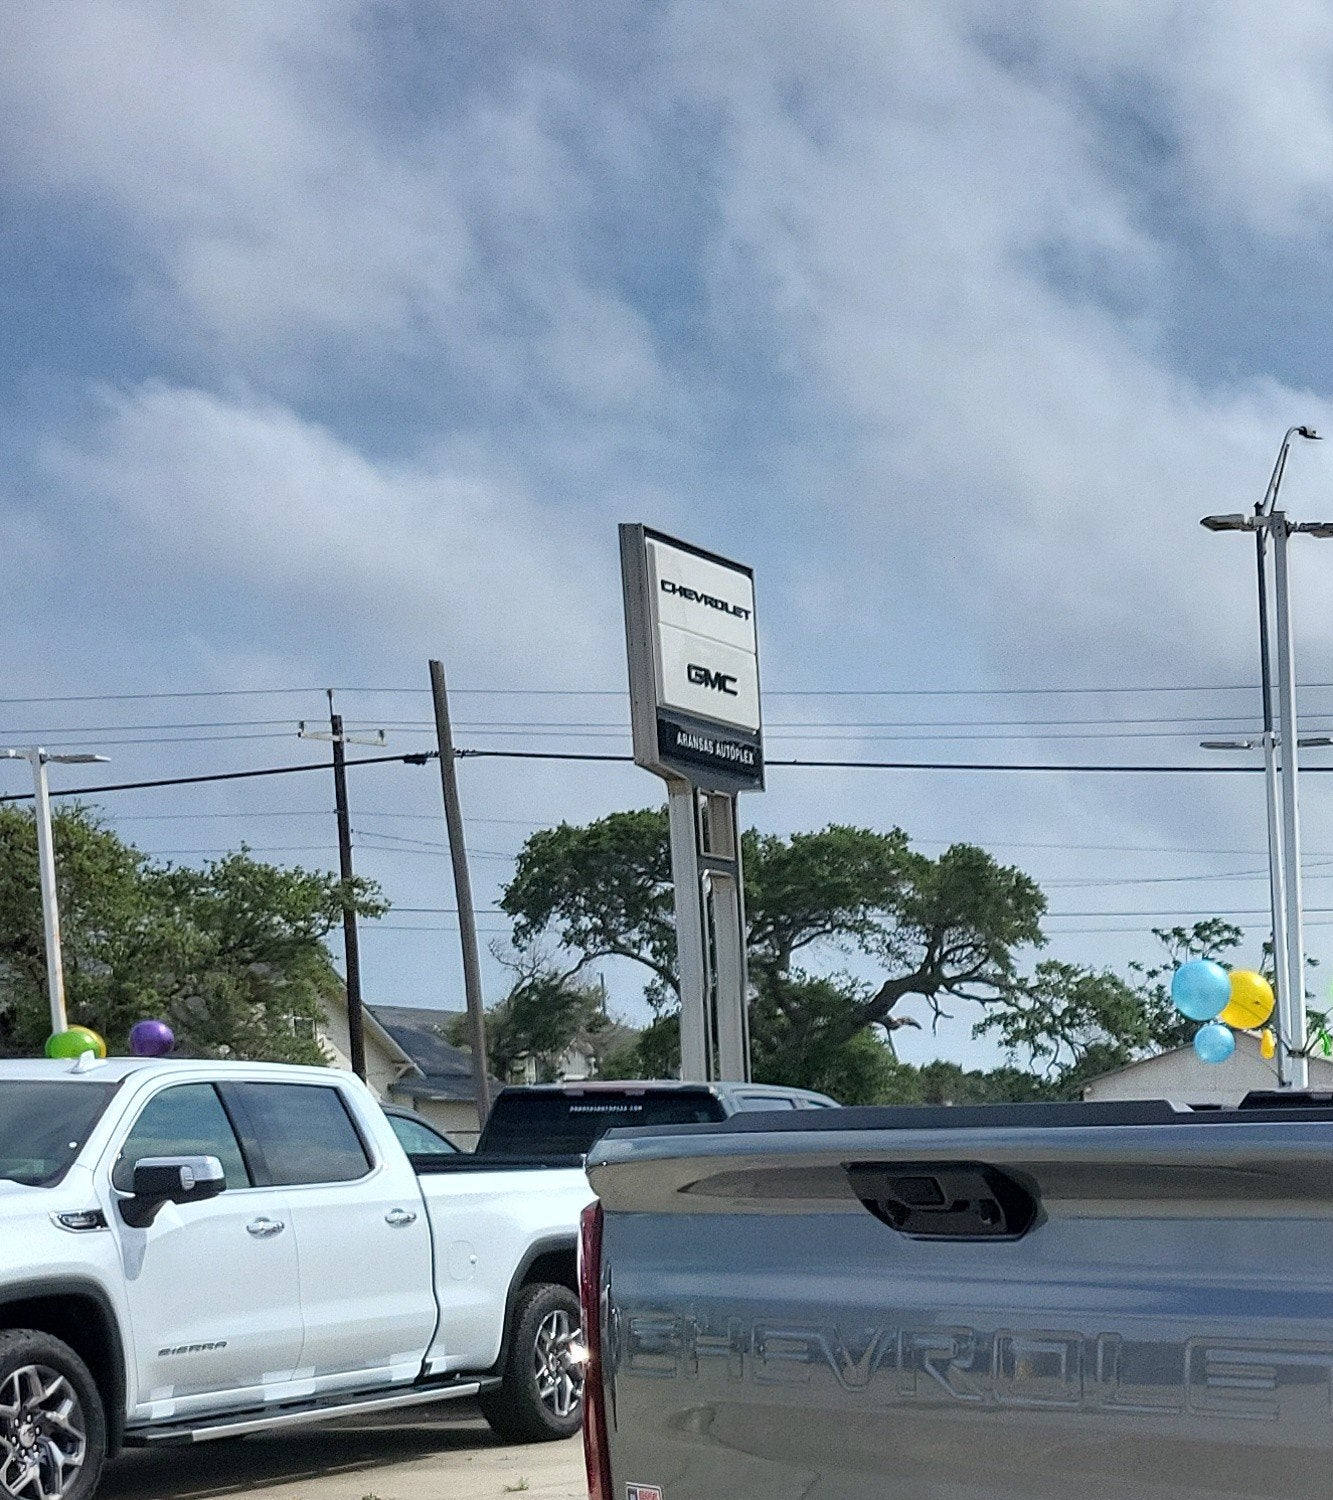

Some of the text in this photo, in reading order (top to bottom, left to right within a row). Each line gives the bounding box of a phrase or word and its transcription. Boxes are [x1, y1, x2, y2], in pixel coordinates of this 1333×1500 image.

[660, 579, 751, 621] CHEVROLET
[687, 663, 738, 696] GMC
[676, 731, 755, 765] ARANSAS AUTOPLEX
